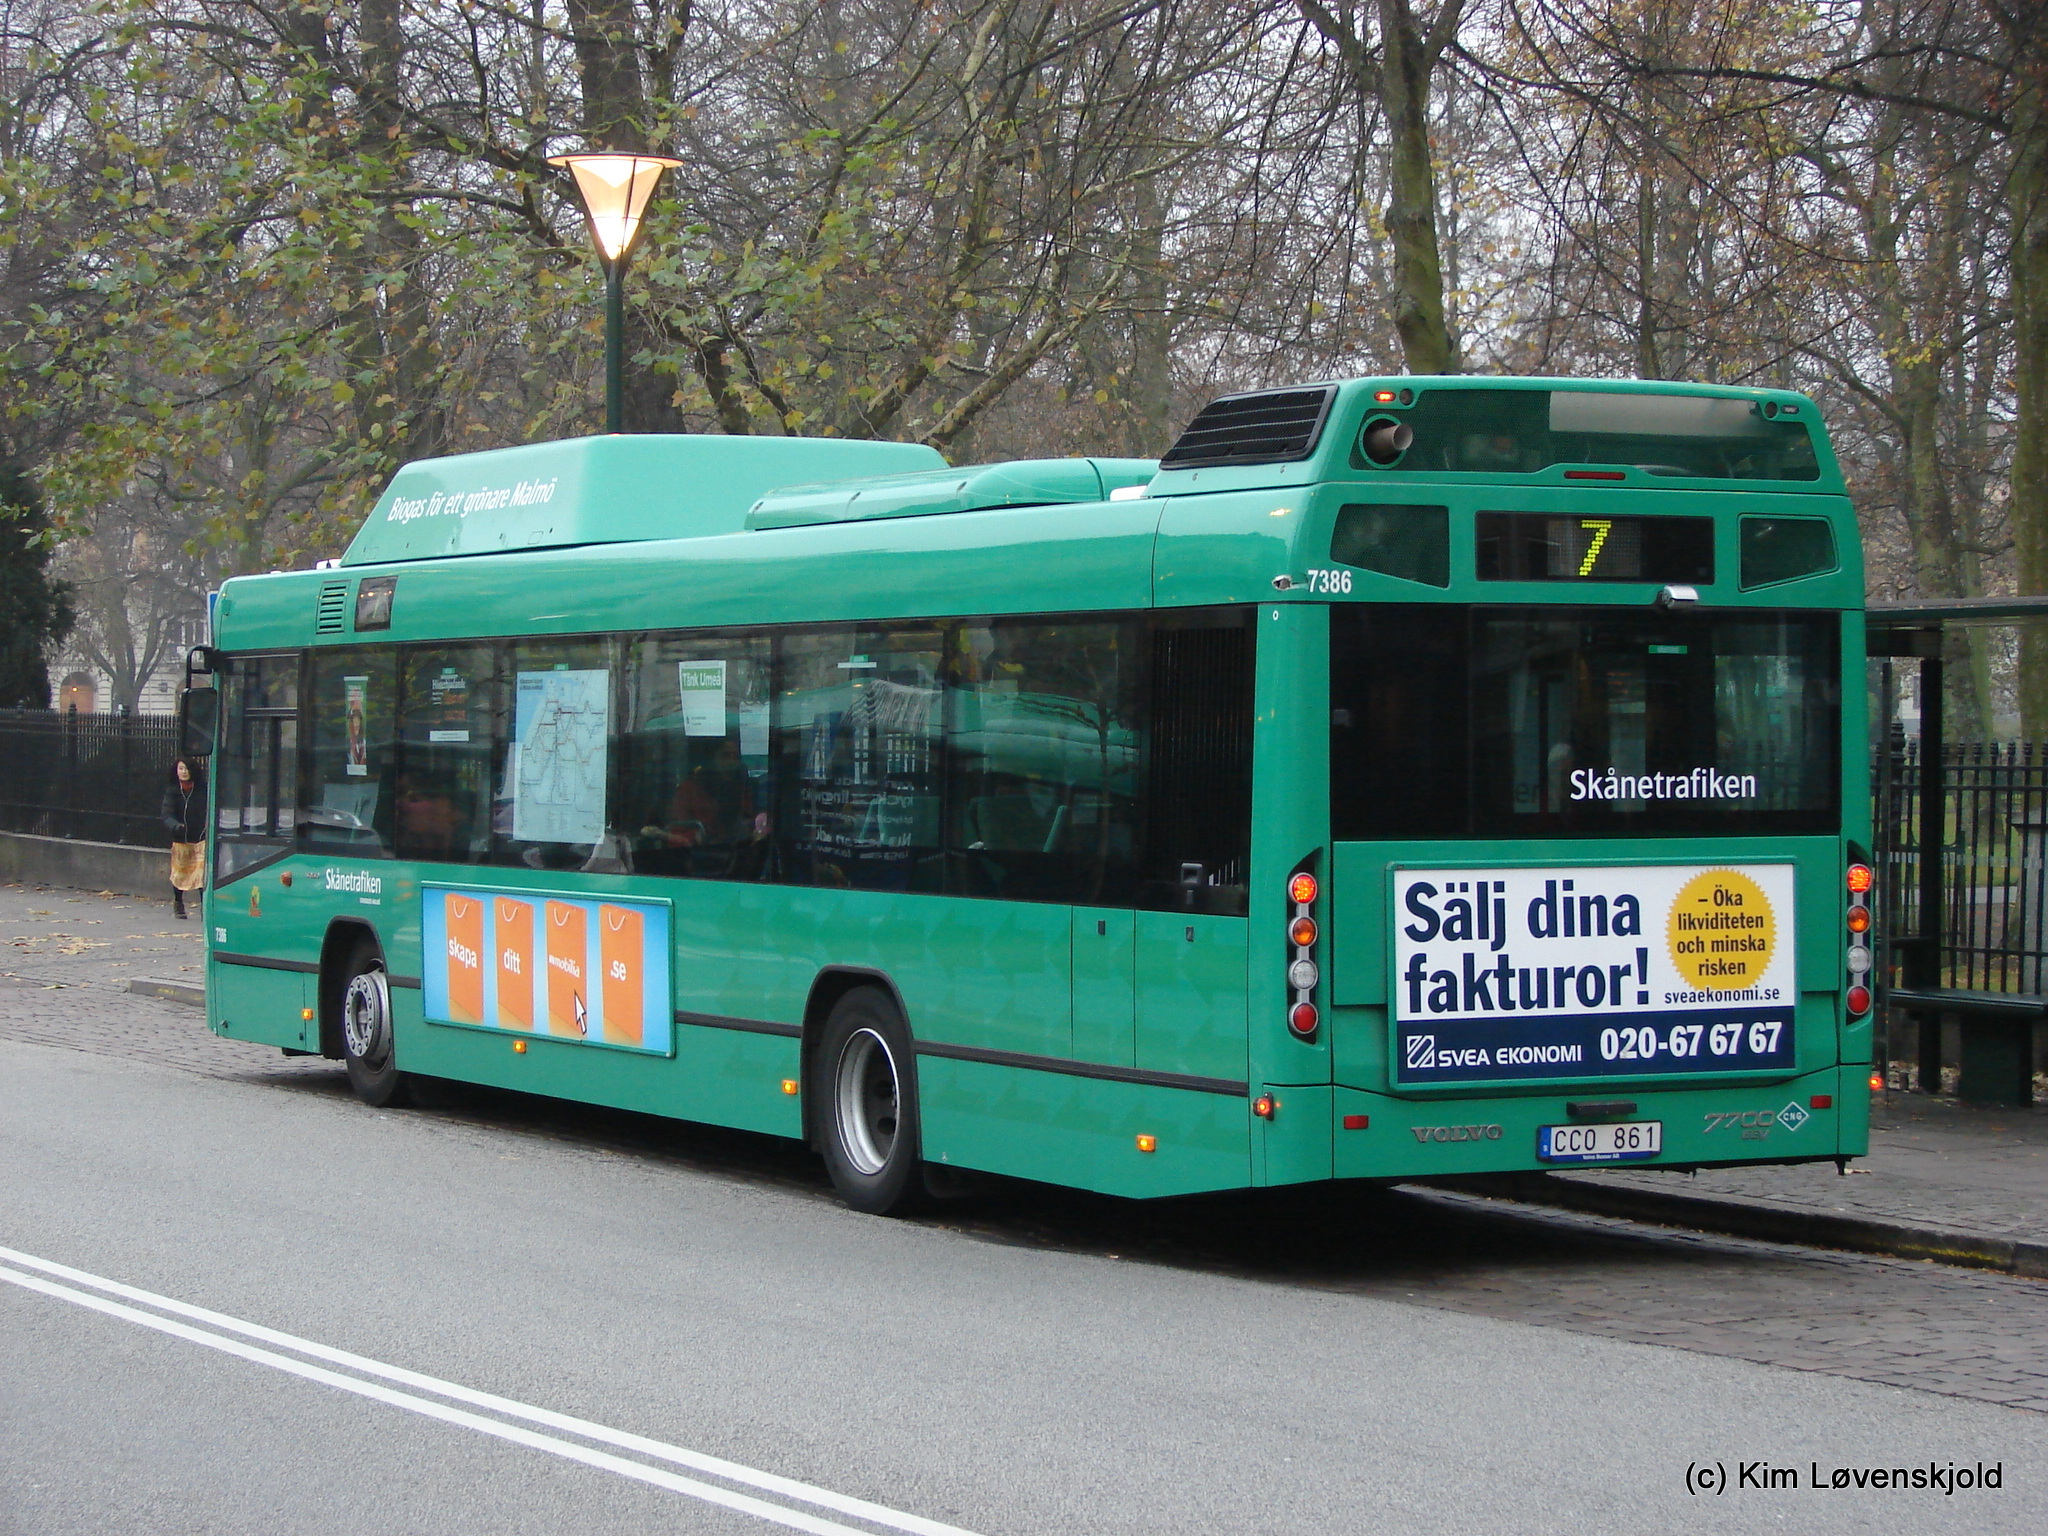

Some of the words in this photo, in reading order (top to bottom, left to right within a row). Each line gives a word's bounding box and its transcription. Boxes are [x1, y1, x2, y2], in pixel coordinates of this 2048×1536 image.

[387, 497, 425, 524] Biogas
[426, 491, 446, 517] för
[444, 491, 464, 514] ett
[460, 487, 510, 518] grönare
[509, 477, 558, 507] Malmö
[1579, 520, 1611, 577] 7
[1307, 569, 1352, 594] 7386
[1569, 767, 1756, 801] Skånetrafiken
[325, 867, 382, 895] Skånetrafiken
[1713, 884, 1744, 907] Öka
[1403, 879, 1506, 952] Sälj
[1527, 879, 1641, 939] dina
[1677, 912, 1764, 931] likviditeten
[449, 936, 478, 969] skapa
[1677, 936, 1705, 954] och
[1711, 934, 1766, 953] minska
[503, 948, 522, 975] ditt
[610, 959, 627, 981] .se
[1698, 958, 1746, 976] risken
[1404, 947, 1650, 1014] fakturor!
[1664, 985, 1780, 1004] sveaekonomi.se
[1600, 1025, 1704, 1061] 020-67
[1709, 1022, 1744, 1056] 67
[1748, 1021, 1783, 1054] 67
[1438, 1048, 1491, 1067] SVEA
[1496, 1044, 1582, 1065] EKONOMI
[1703, 1110, 1776, 1134] 7700
[1782, 1112, 1803, 1121] CNG
[1411, 1124, 1503, 1144] VOLVO
[1555, 1128, 1597, 1152] CCO
[1614, 1126, 1654, 1150] 861
